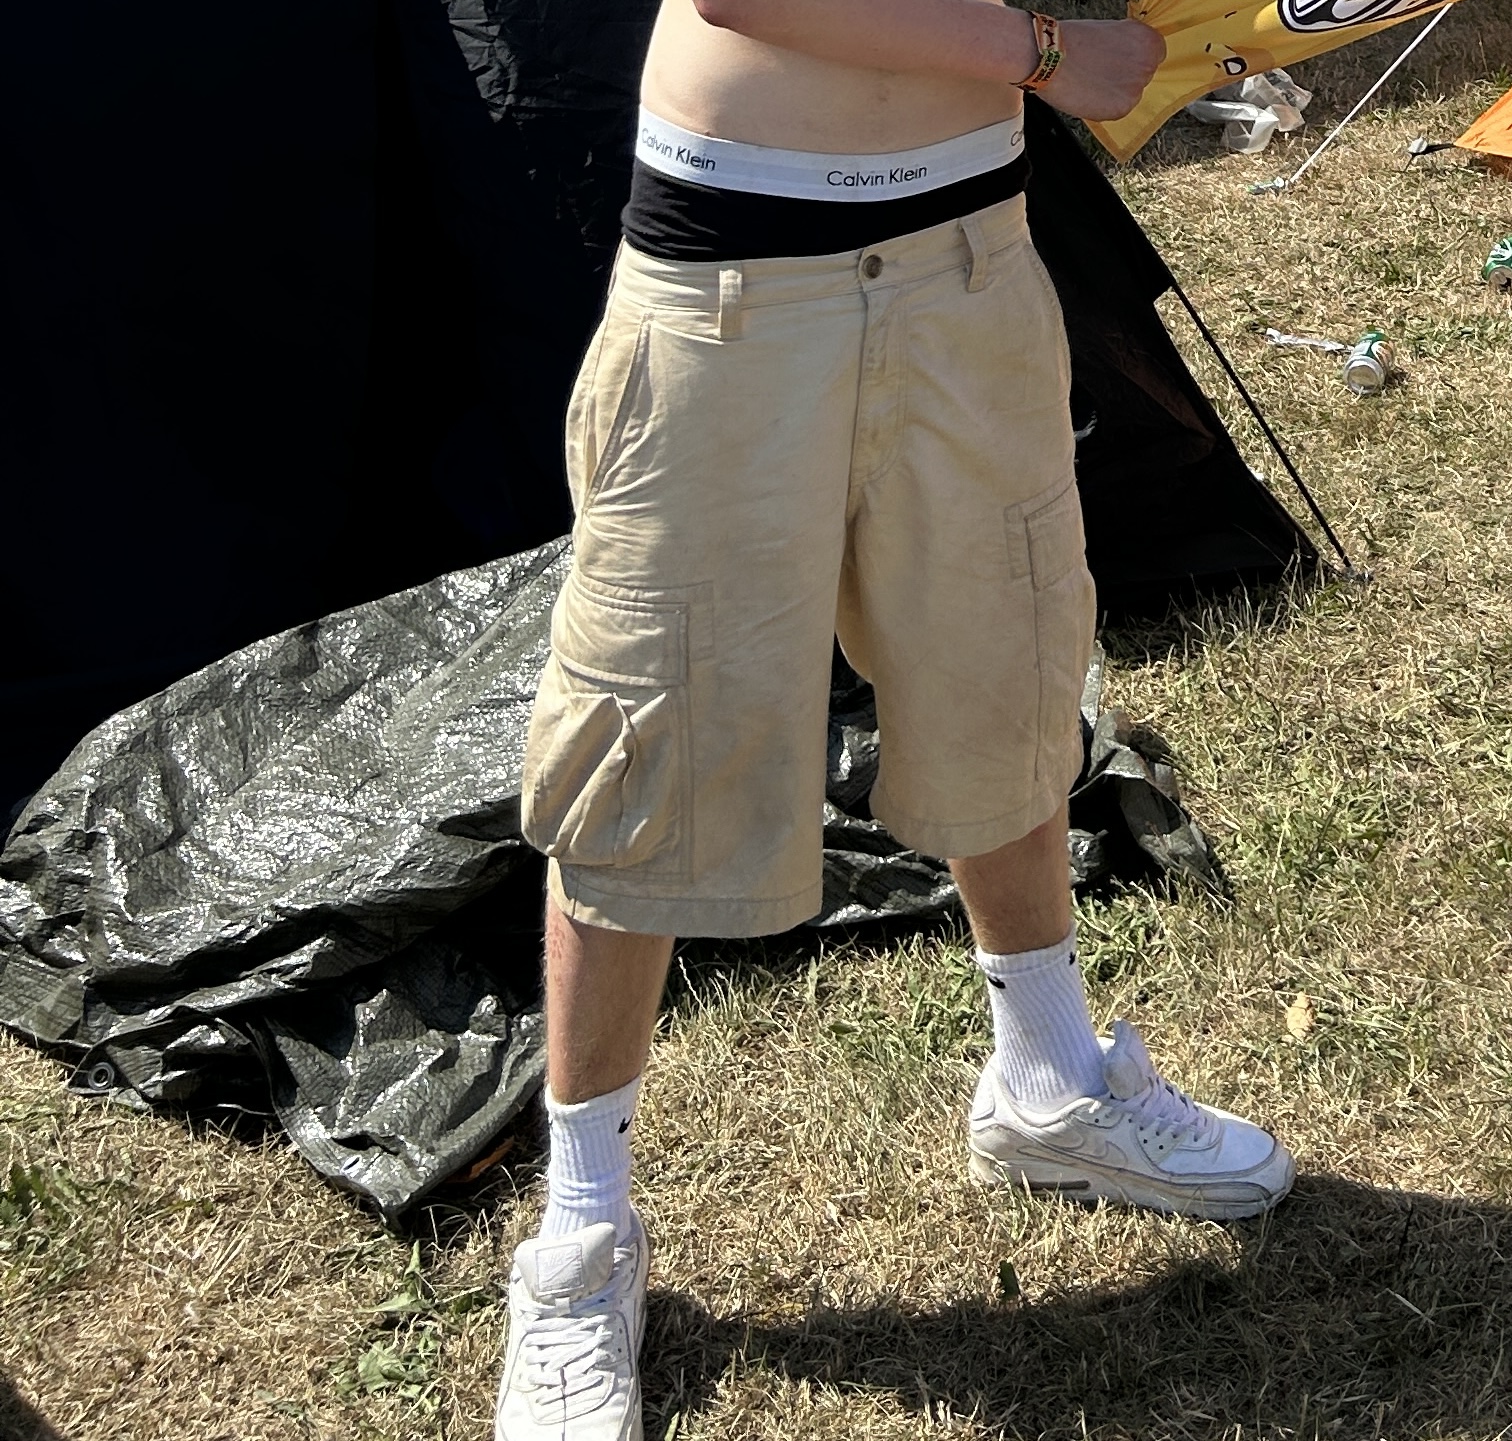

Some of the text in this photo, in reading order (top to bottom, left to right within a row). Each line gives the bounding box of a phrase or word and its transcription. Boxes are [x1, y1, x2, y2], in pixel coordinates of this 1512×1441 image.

[641, 127, 716, 171] Calvin Klein
[826, 164, 928, 187] Calvin Klein
